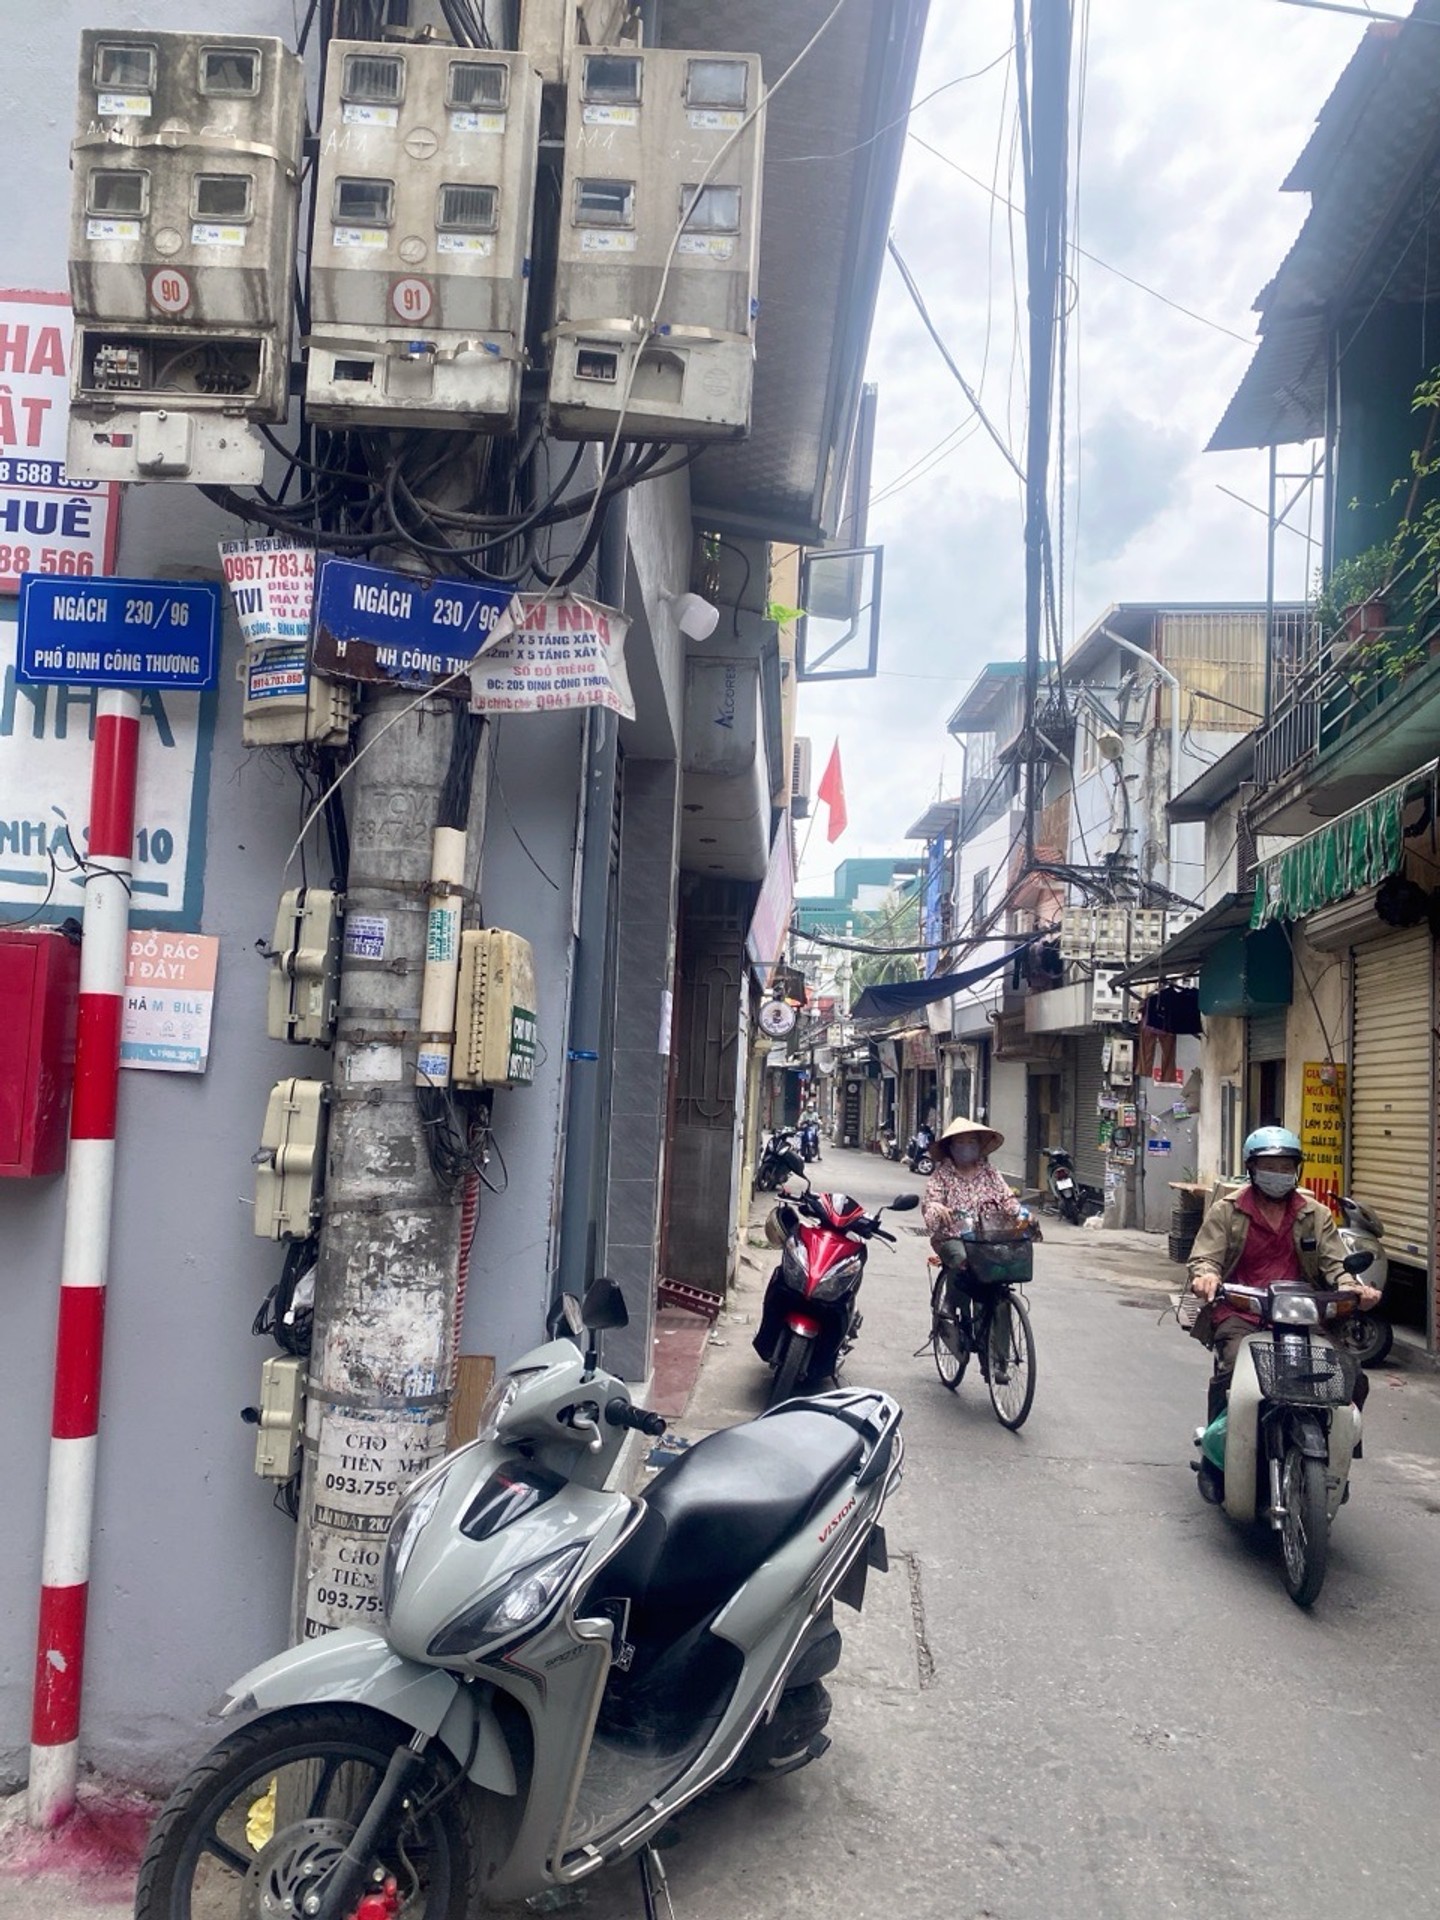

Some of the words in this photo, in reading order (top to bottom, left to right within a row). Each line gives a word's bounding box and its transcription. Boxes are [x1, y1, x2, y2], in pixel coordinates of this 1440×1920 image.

[160, 279, 182, 303] 90
[403, 288, 422, 311] 91
[16, 464, 52, 484] 588
[0, 497, 92, 538] HUÊ
[40, 549, 94, 577] 566
[53, 591, 108, 623] NGÁCH
[232, 587, 263, 618] TIVI
[353, 583, 413, 620] NGÁCH
[34, 644, 65, 669] PHỐ
[66, 651, 100, 674] ĐỊNH
[103, 649, 142, 672] CÔNG
[146, 654, 200, 680] THƯỢNG
[401, 648, 443, 673] CÔNG
[507, 679, 525, 691] 205
[553, 676, 581, 691] CÔNG
[136, 828, 174, 865] 10
[162, 939, 200, 960] RÁC
[139, 959, 186, 980] ĐÂY!
[345, 1433, 387, 1452] CHO
[818, 1496, 857, 1543] VISION
[338, 1548, 380, 1566] CHO
